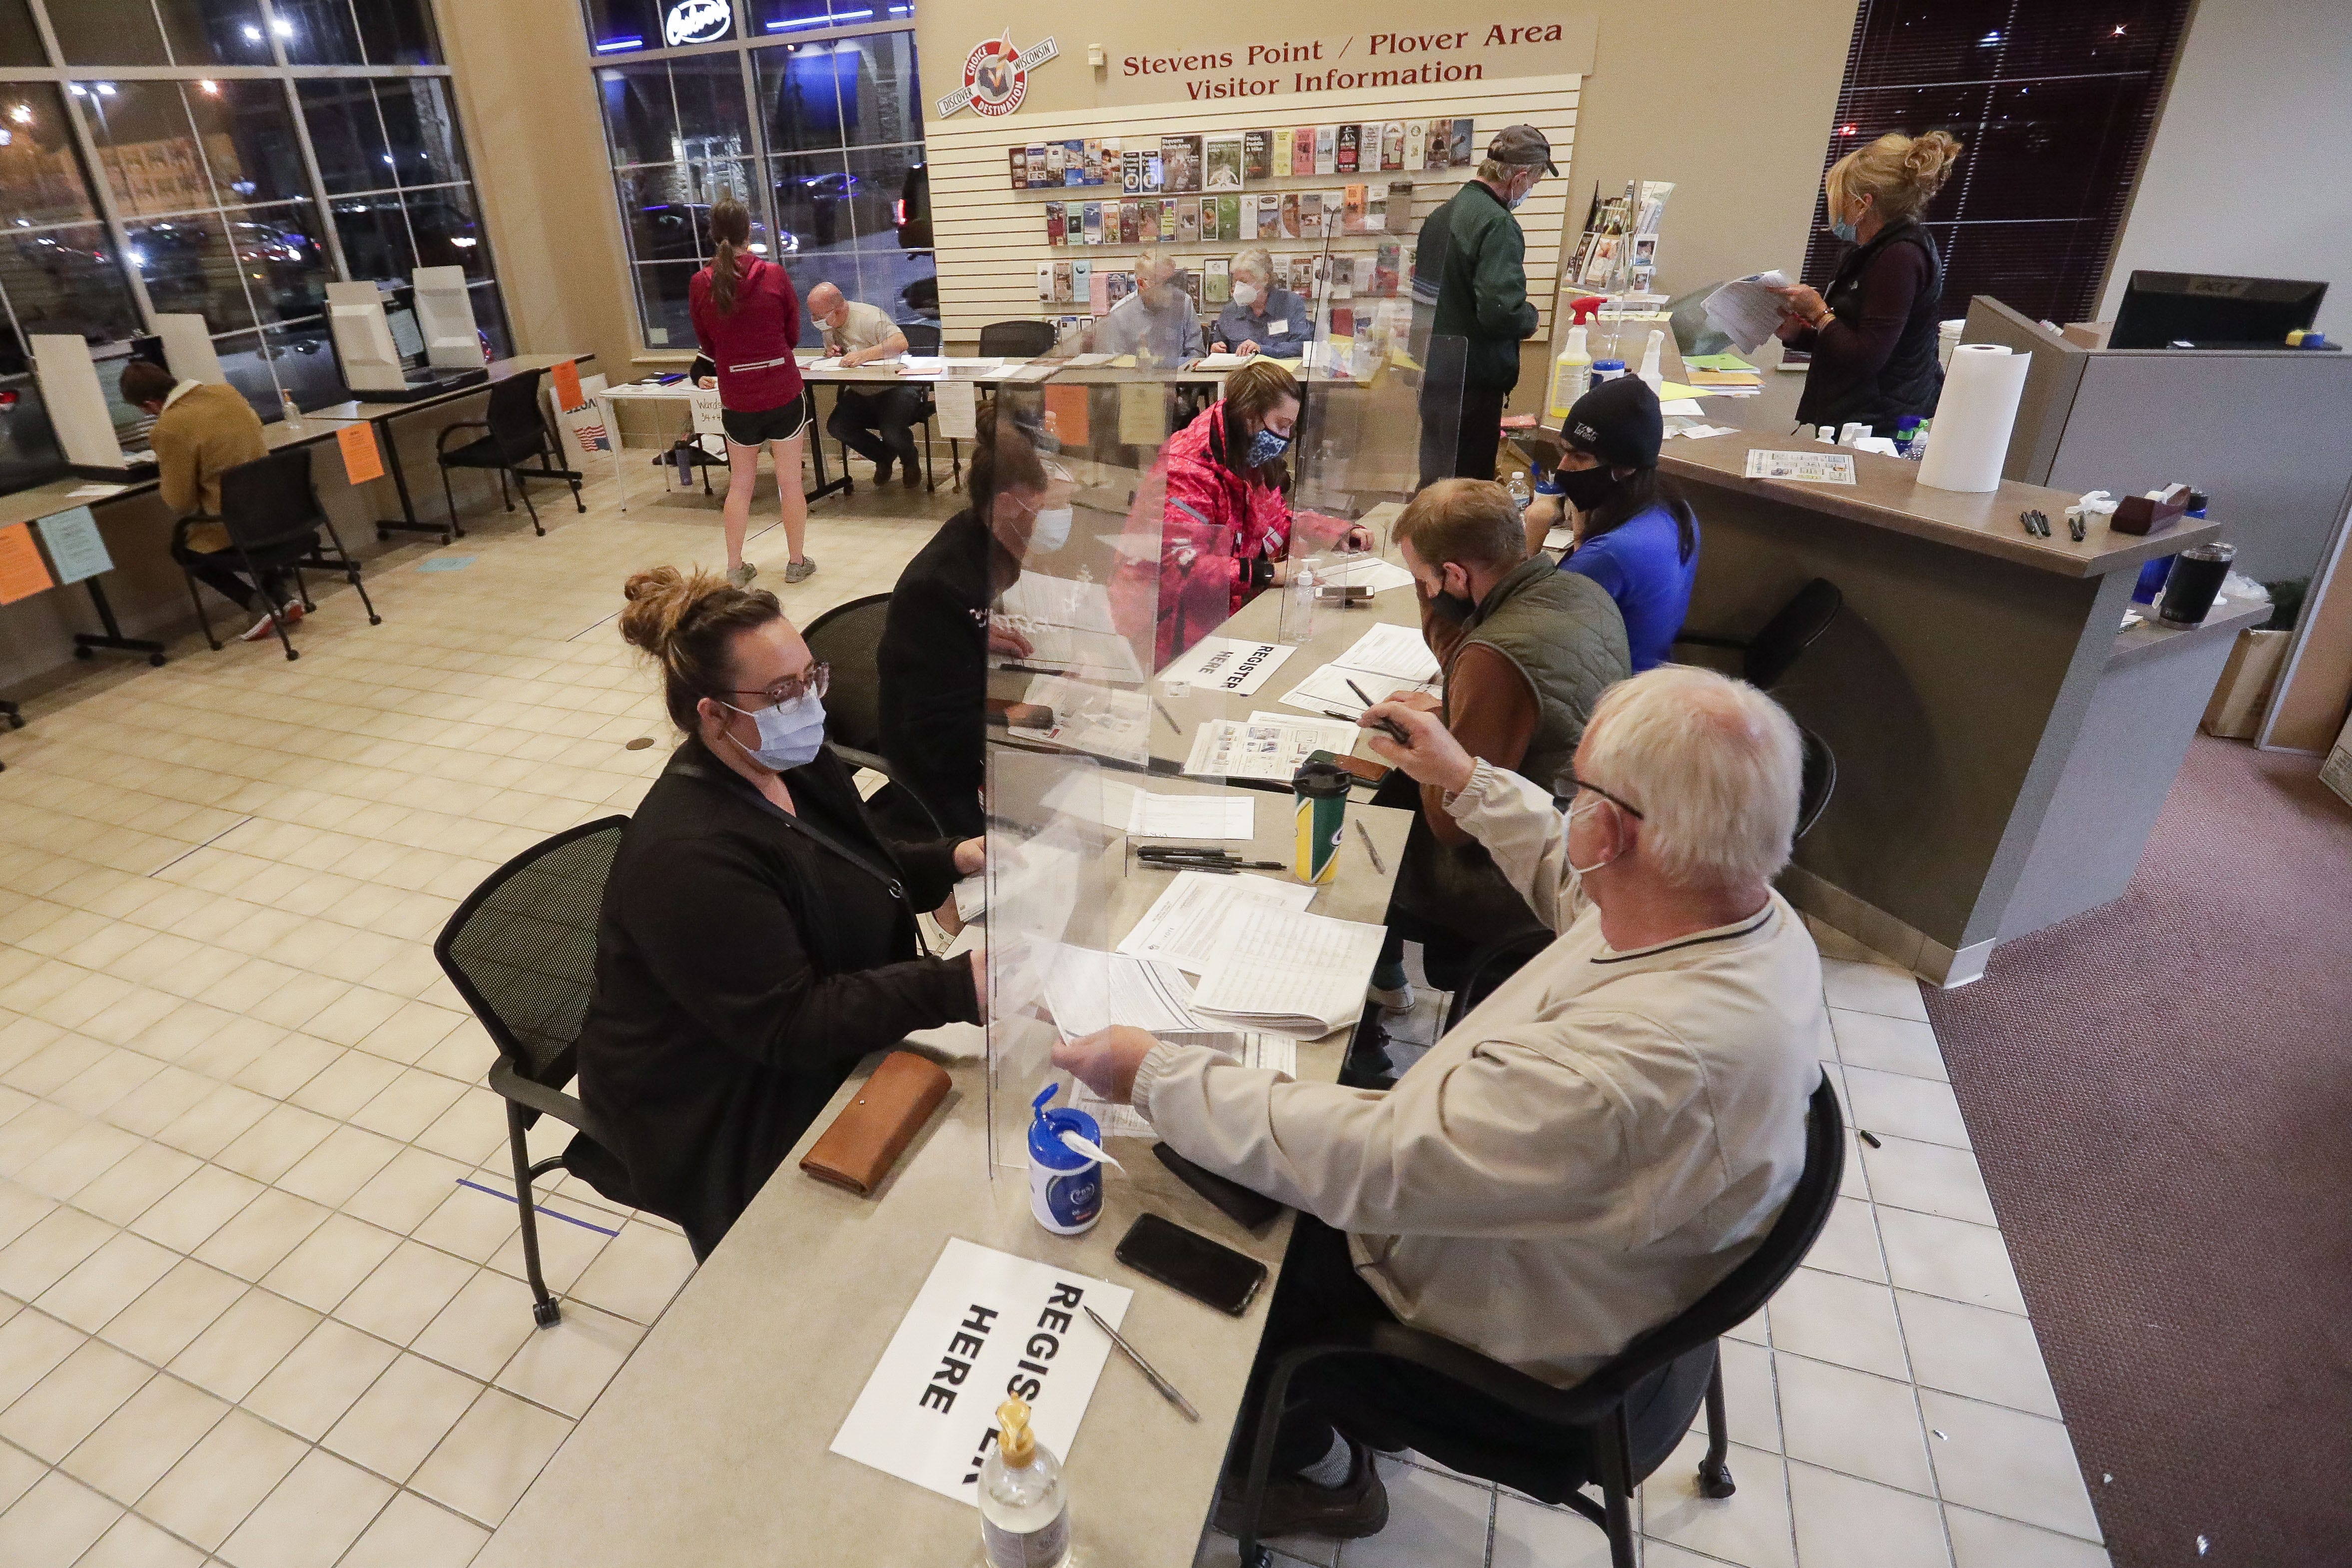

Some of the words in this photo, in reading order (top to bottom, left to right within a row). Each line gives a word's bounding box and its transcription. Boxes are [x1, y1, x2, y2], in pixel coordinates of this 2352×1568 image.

[966, 45, 989, 76] CHOICE
[1124, 54, 1233, 76] Stevens
[1248, 40, 1323, 65] Point
[1338, 35, 1353, 59] /
[1369, 31, 1468, 55] Plover
[1483, 23, 1563, 47] Area
[943, 87, 974, 111] DISCOVER
[1013, 42, 1051, 71] WISCONSIN
[1186, 78, 1280, 100] Visitor
[1294, 60, 1484, 93] Information
[977, 80, 1025, 116] DESTINATION
[1198, 651, 1234, 675] HERE
[1219, 645, 1274, 689] REGISTER
[919, 1304, 999, 1415] HERE
